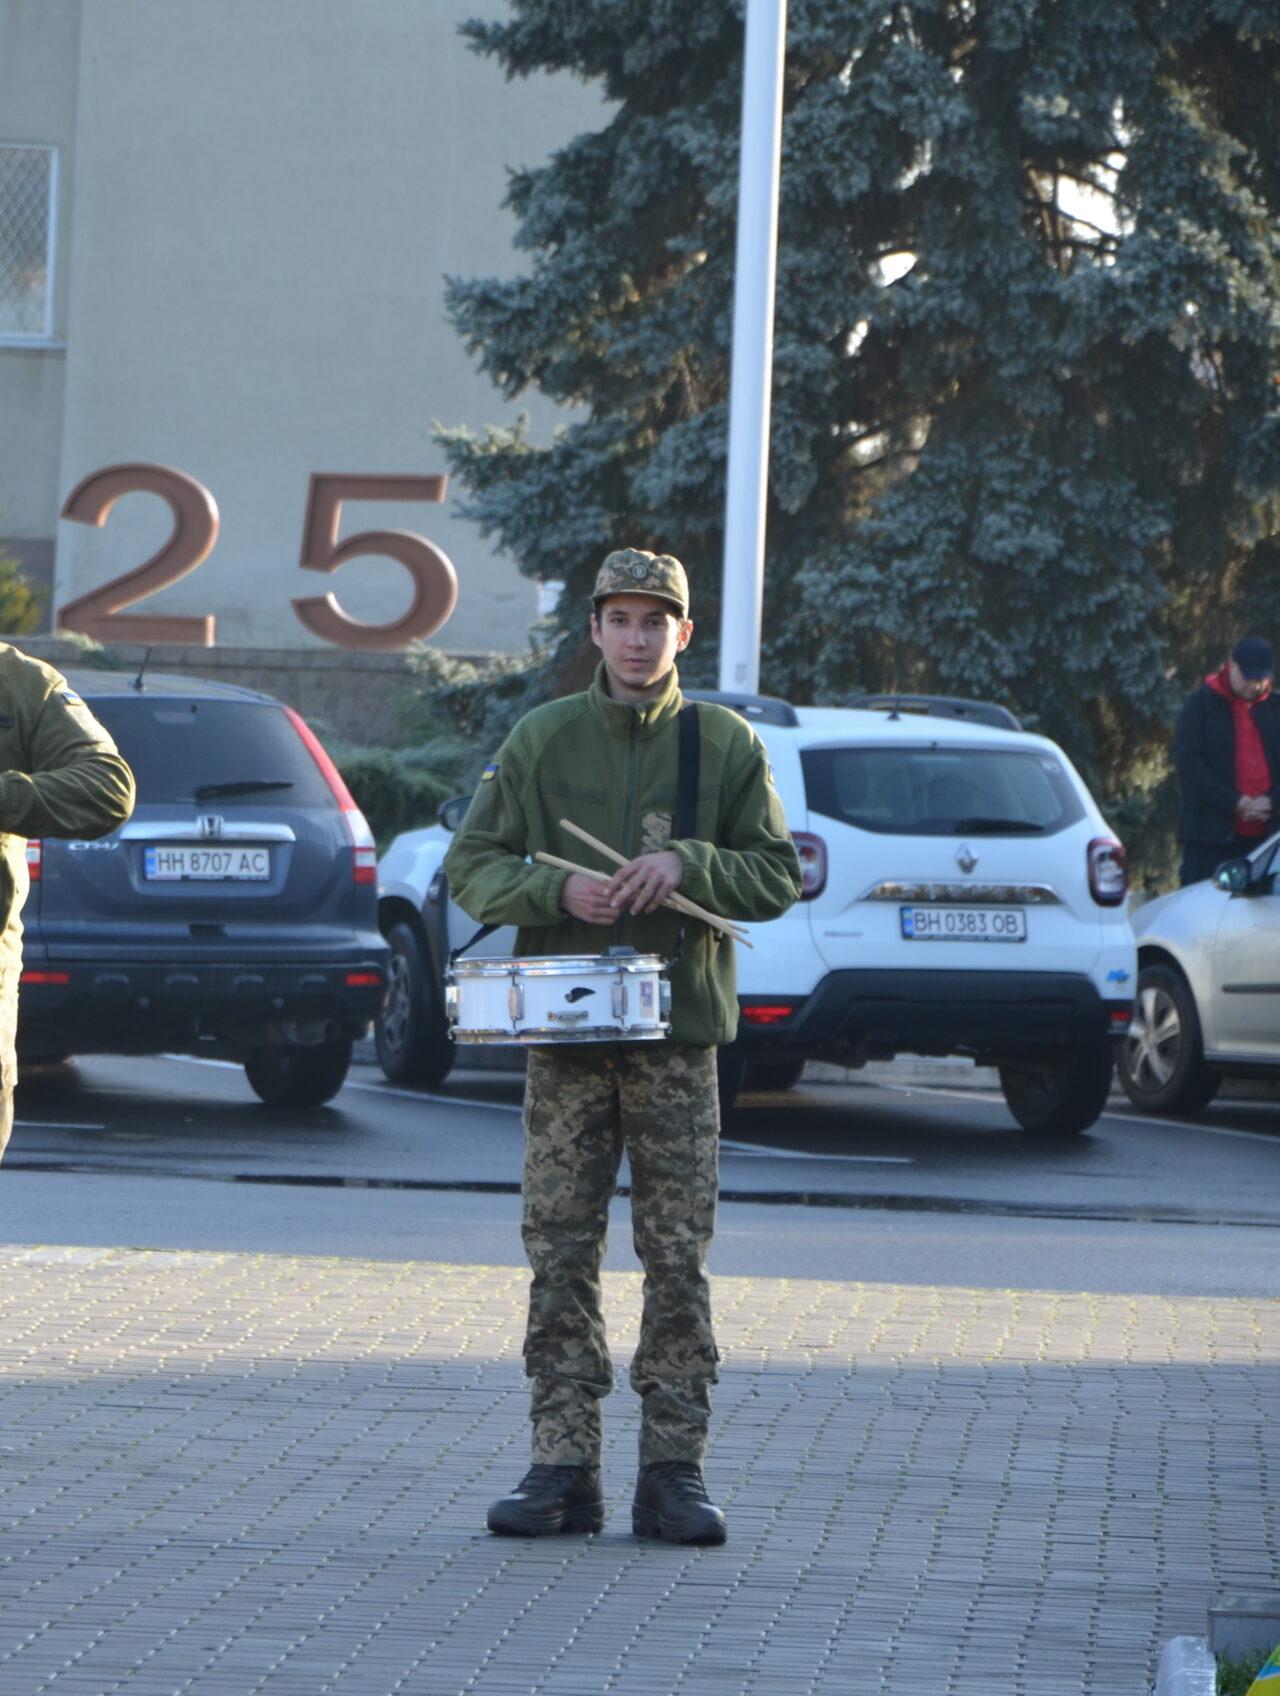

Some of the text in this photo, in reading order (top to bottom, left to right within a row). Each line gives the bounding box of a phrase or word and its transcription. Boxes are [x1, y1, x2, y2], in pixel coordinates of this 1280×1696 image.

[158, 853, 265, 873] HH 8707 AC
[915, 911, 1018, 933] BH 0383 OB
